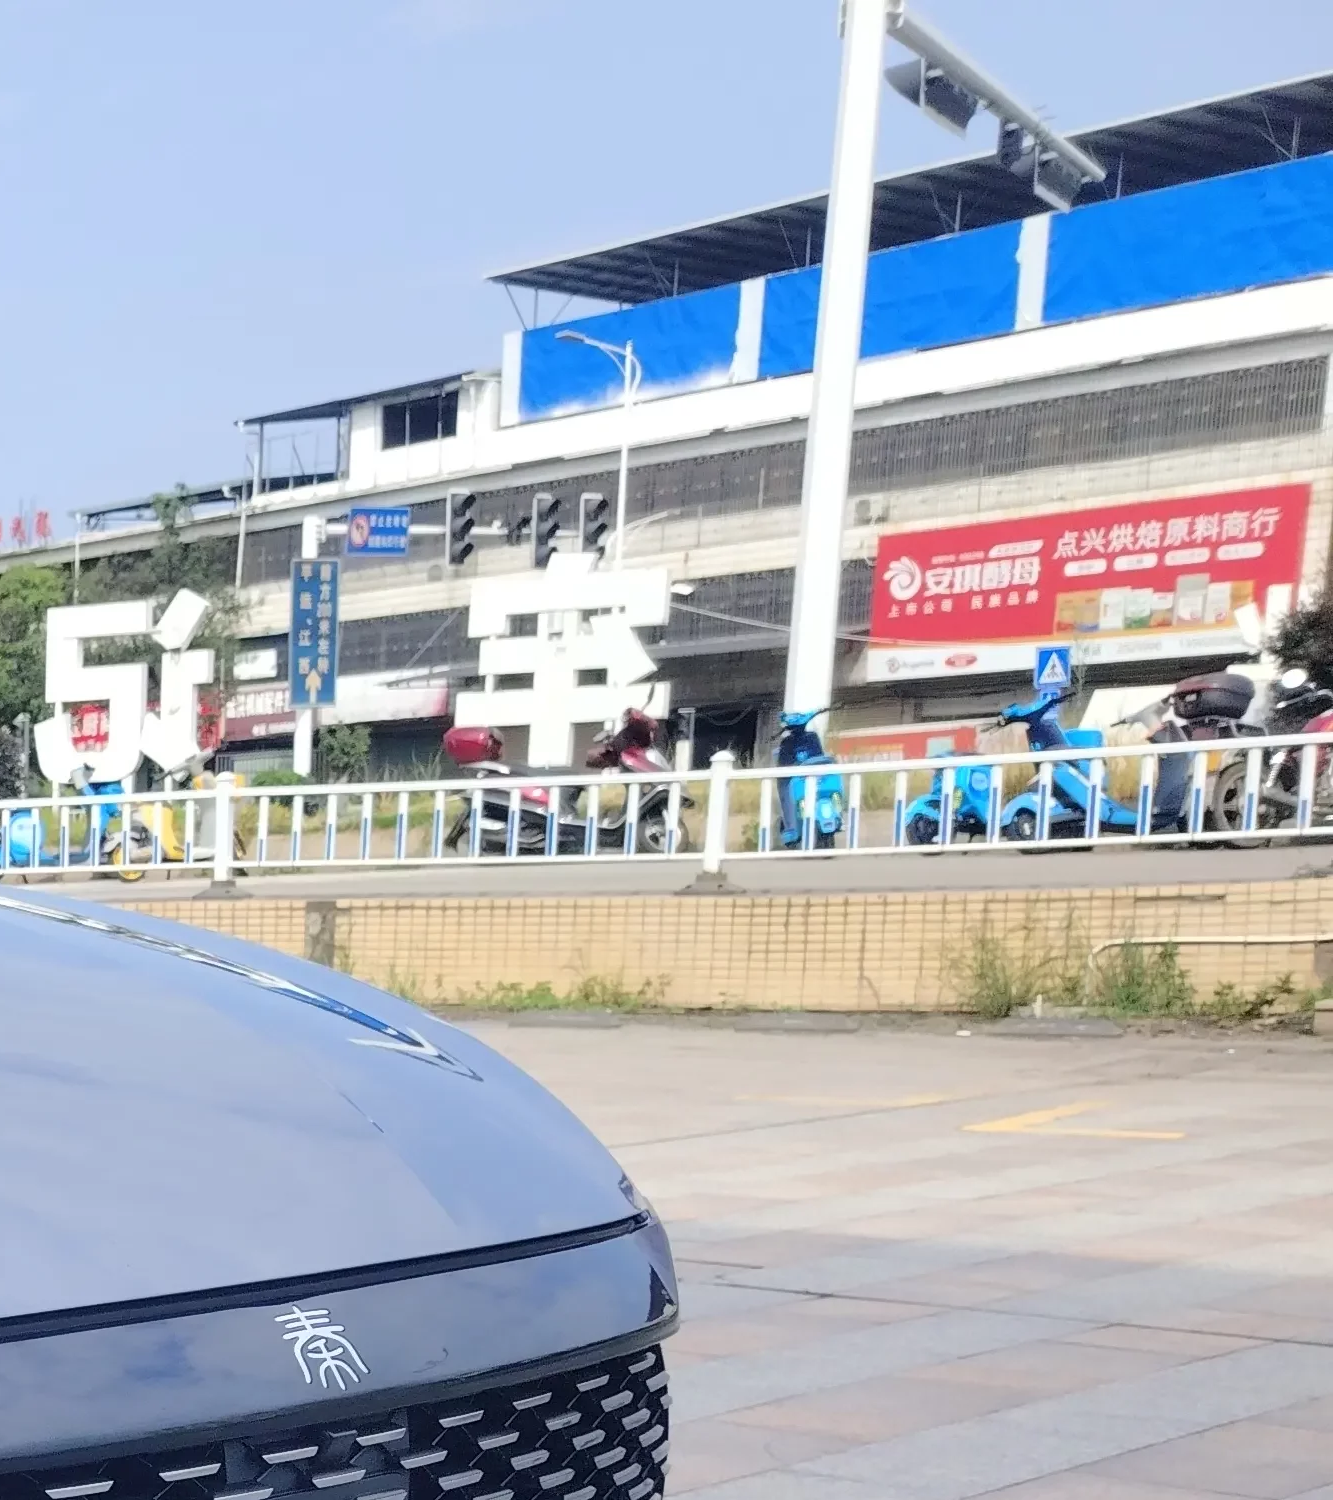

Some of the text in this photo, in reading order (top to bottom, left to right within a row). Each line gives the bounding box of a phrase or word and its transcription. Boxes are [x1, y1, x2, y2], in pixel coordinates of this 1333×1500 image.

[1052, 507, 1283, 560] 点兴烘焙原料商行
[923, 555, 1041, 597] 安琪酵母
[887, 598, 954, 619] 上市公司
